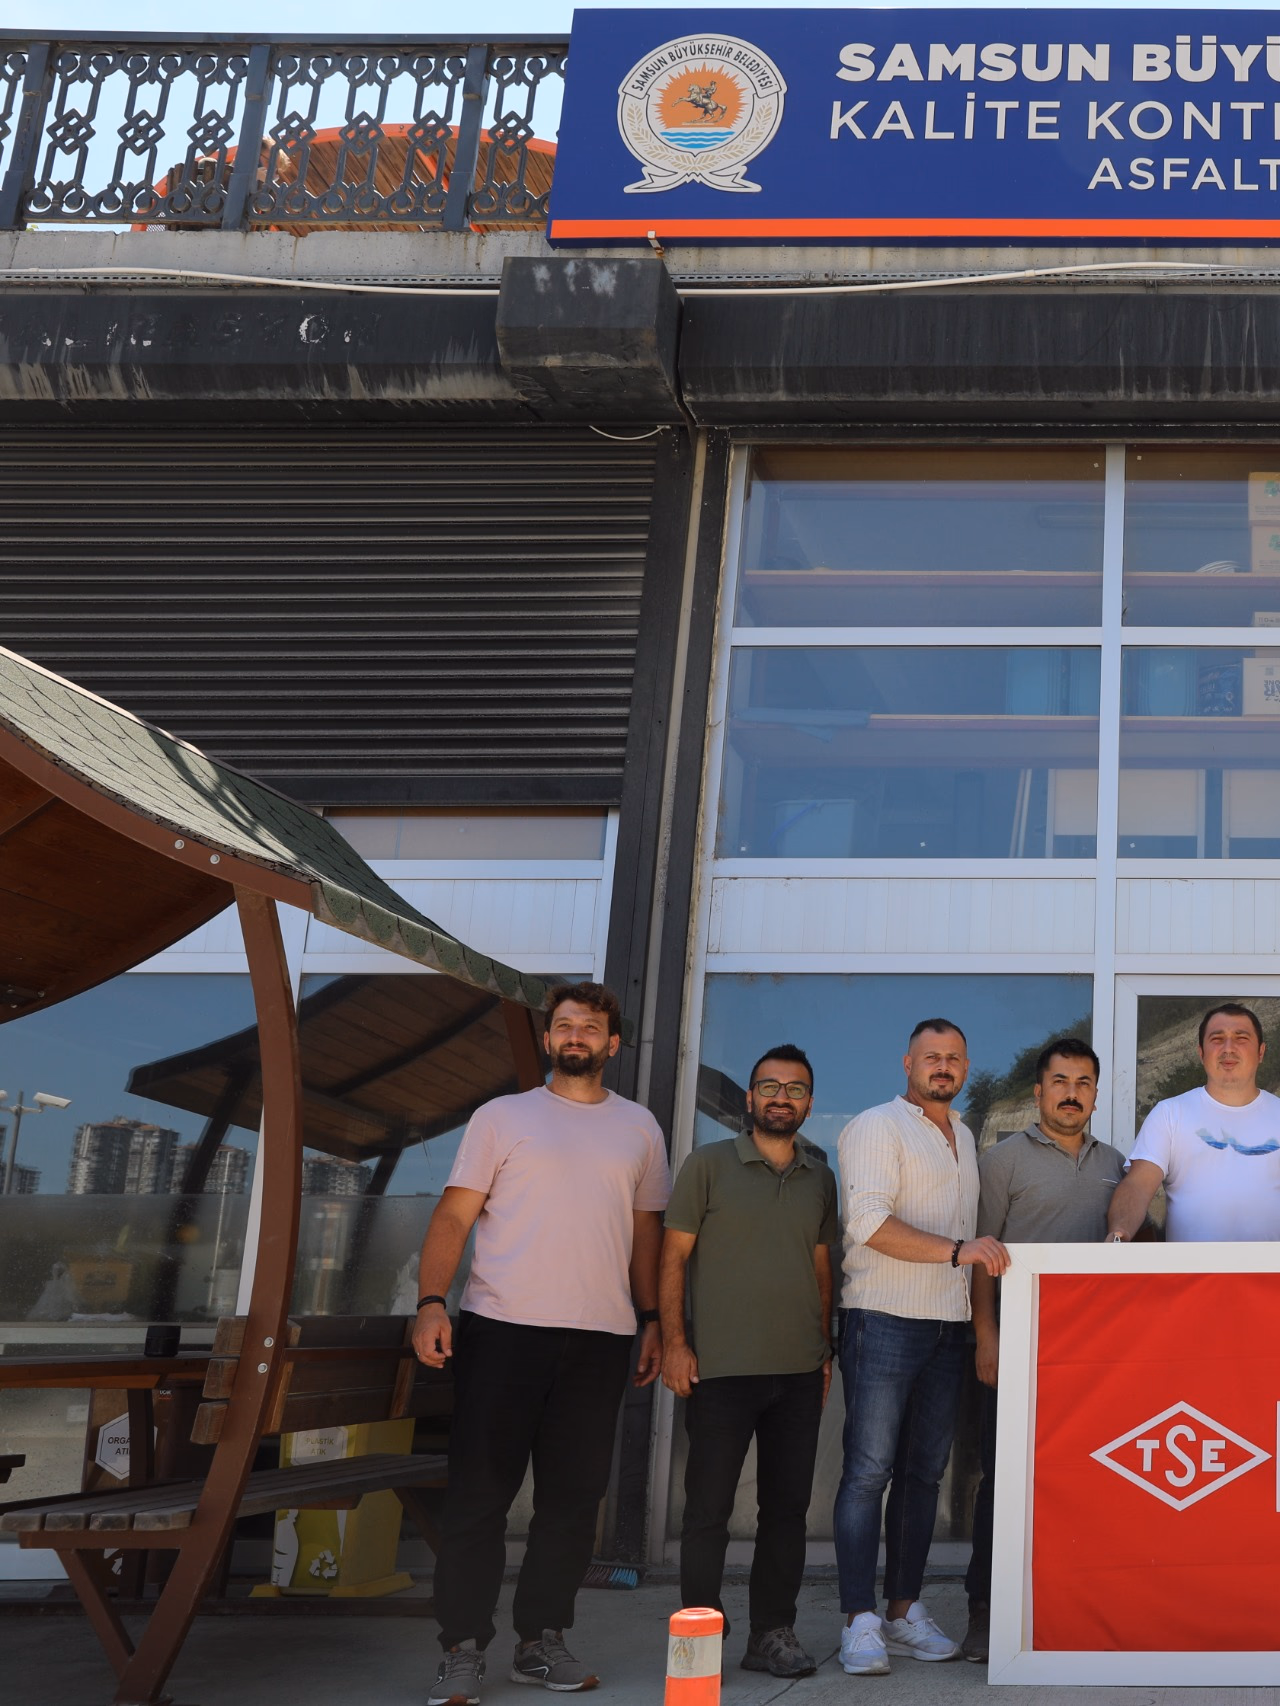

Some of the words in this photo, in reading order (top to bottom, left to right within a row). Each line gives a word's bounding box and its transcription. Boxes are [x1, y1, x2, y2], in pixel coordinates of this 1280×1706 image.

[631, 57, 668, 92] SAMSUN
[669, 41, 734, 62] BÜYÜKŞEHİR
[733, 50, 778, 91] BELEDİYESİ
[836, 42, 1110, 83] SAMSUN
[829, 92, 1061, 140] KALİTE
[107, 1437, 131, 1445] ORGA
[115, 1447, 130, 1456] ATI
[311, 1448, 326, 1456] ATIK
[1136, 1424, 1226, 1487] TSE
